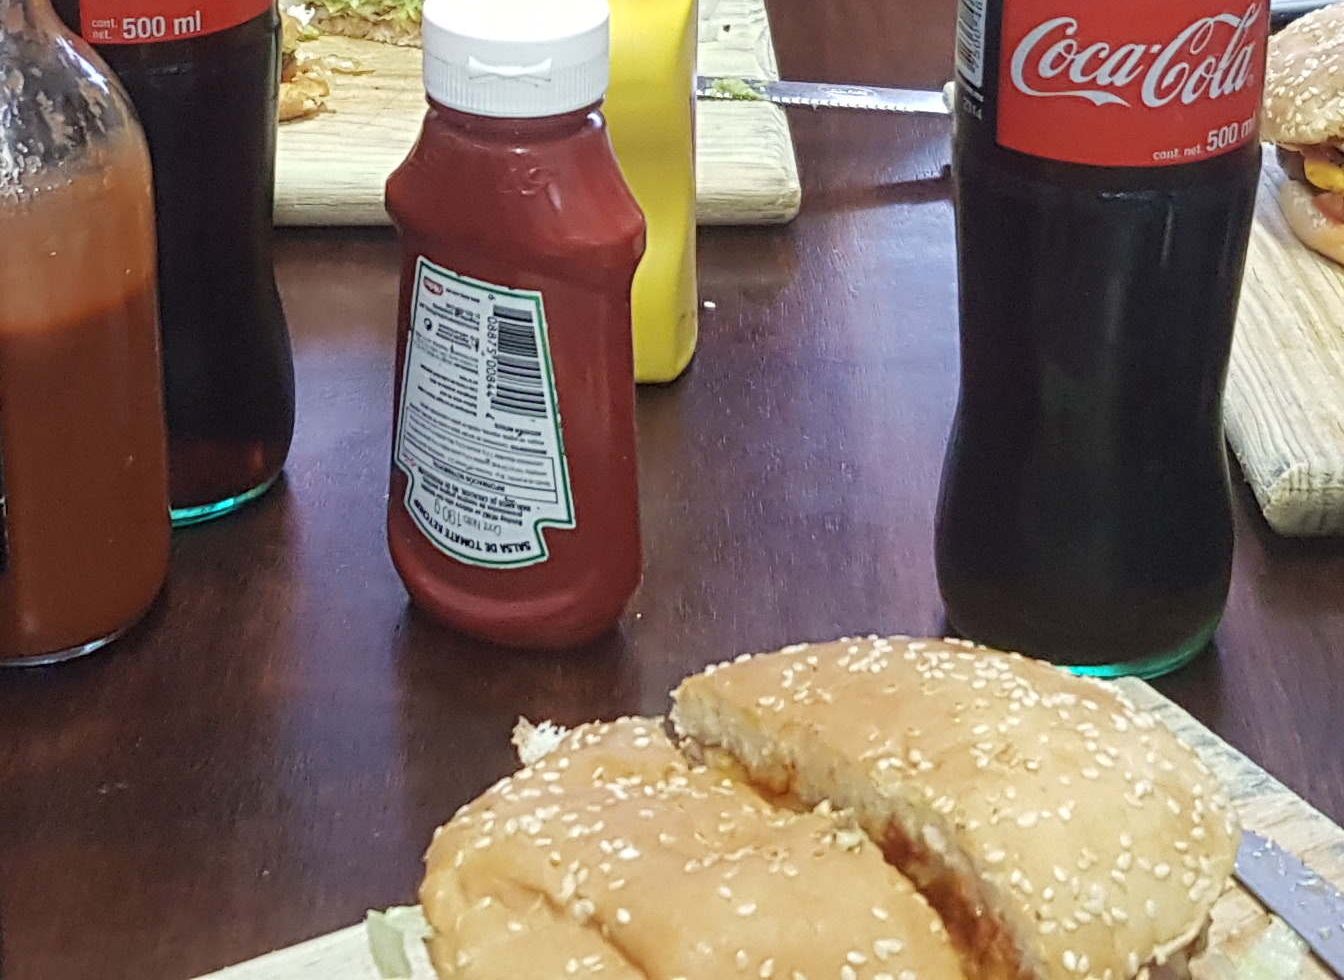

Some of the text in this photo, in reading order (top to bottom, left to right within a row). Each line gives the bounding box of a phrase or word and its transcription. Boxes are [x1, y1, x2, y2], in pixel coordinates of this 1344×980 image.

[123, 11, 201, 39] 500 ml
[1010, 2, 1262, 108] Coca-Cola
[1206, 123, 1239, 152] 500
[444, 528, 483, 551] TOMATE
[484, 542, 498, 553] DE
[500, 541, 532, 554] SALSA
